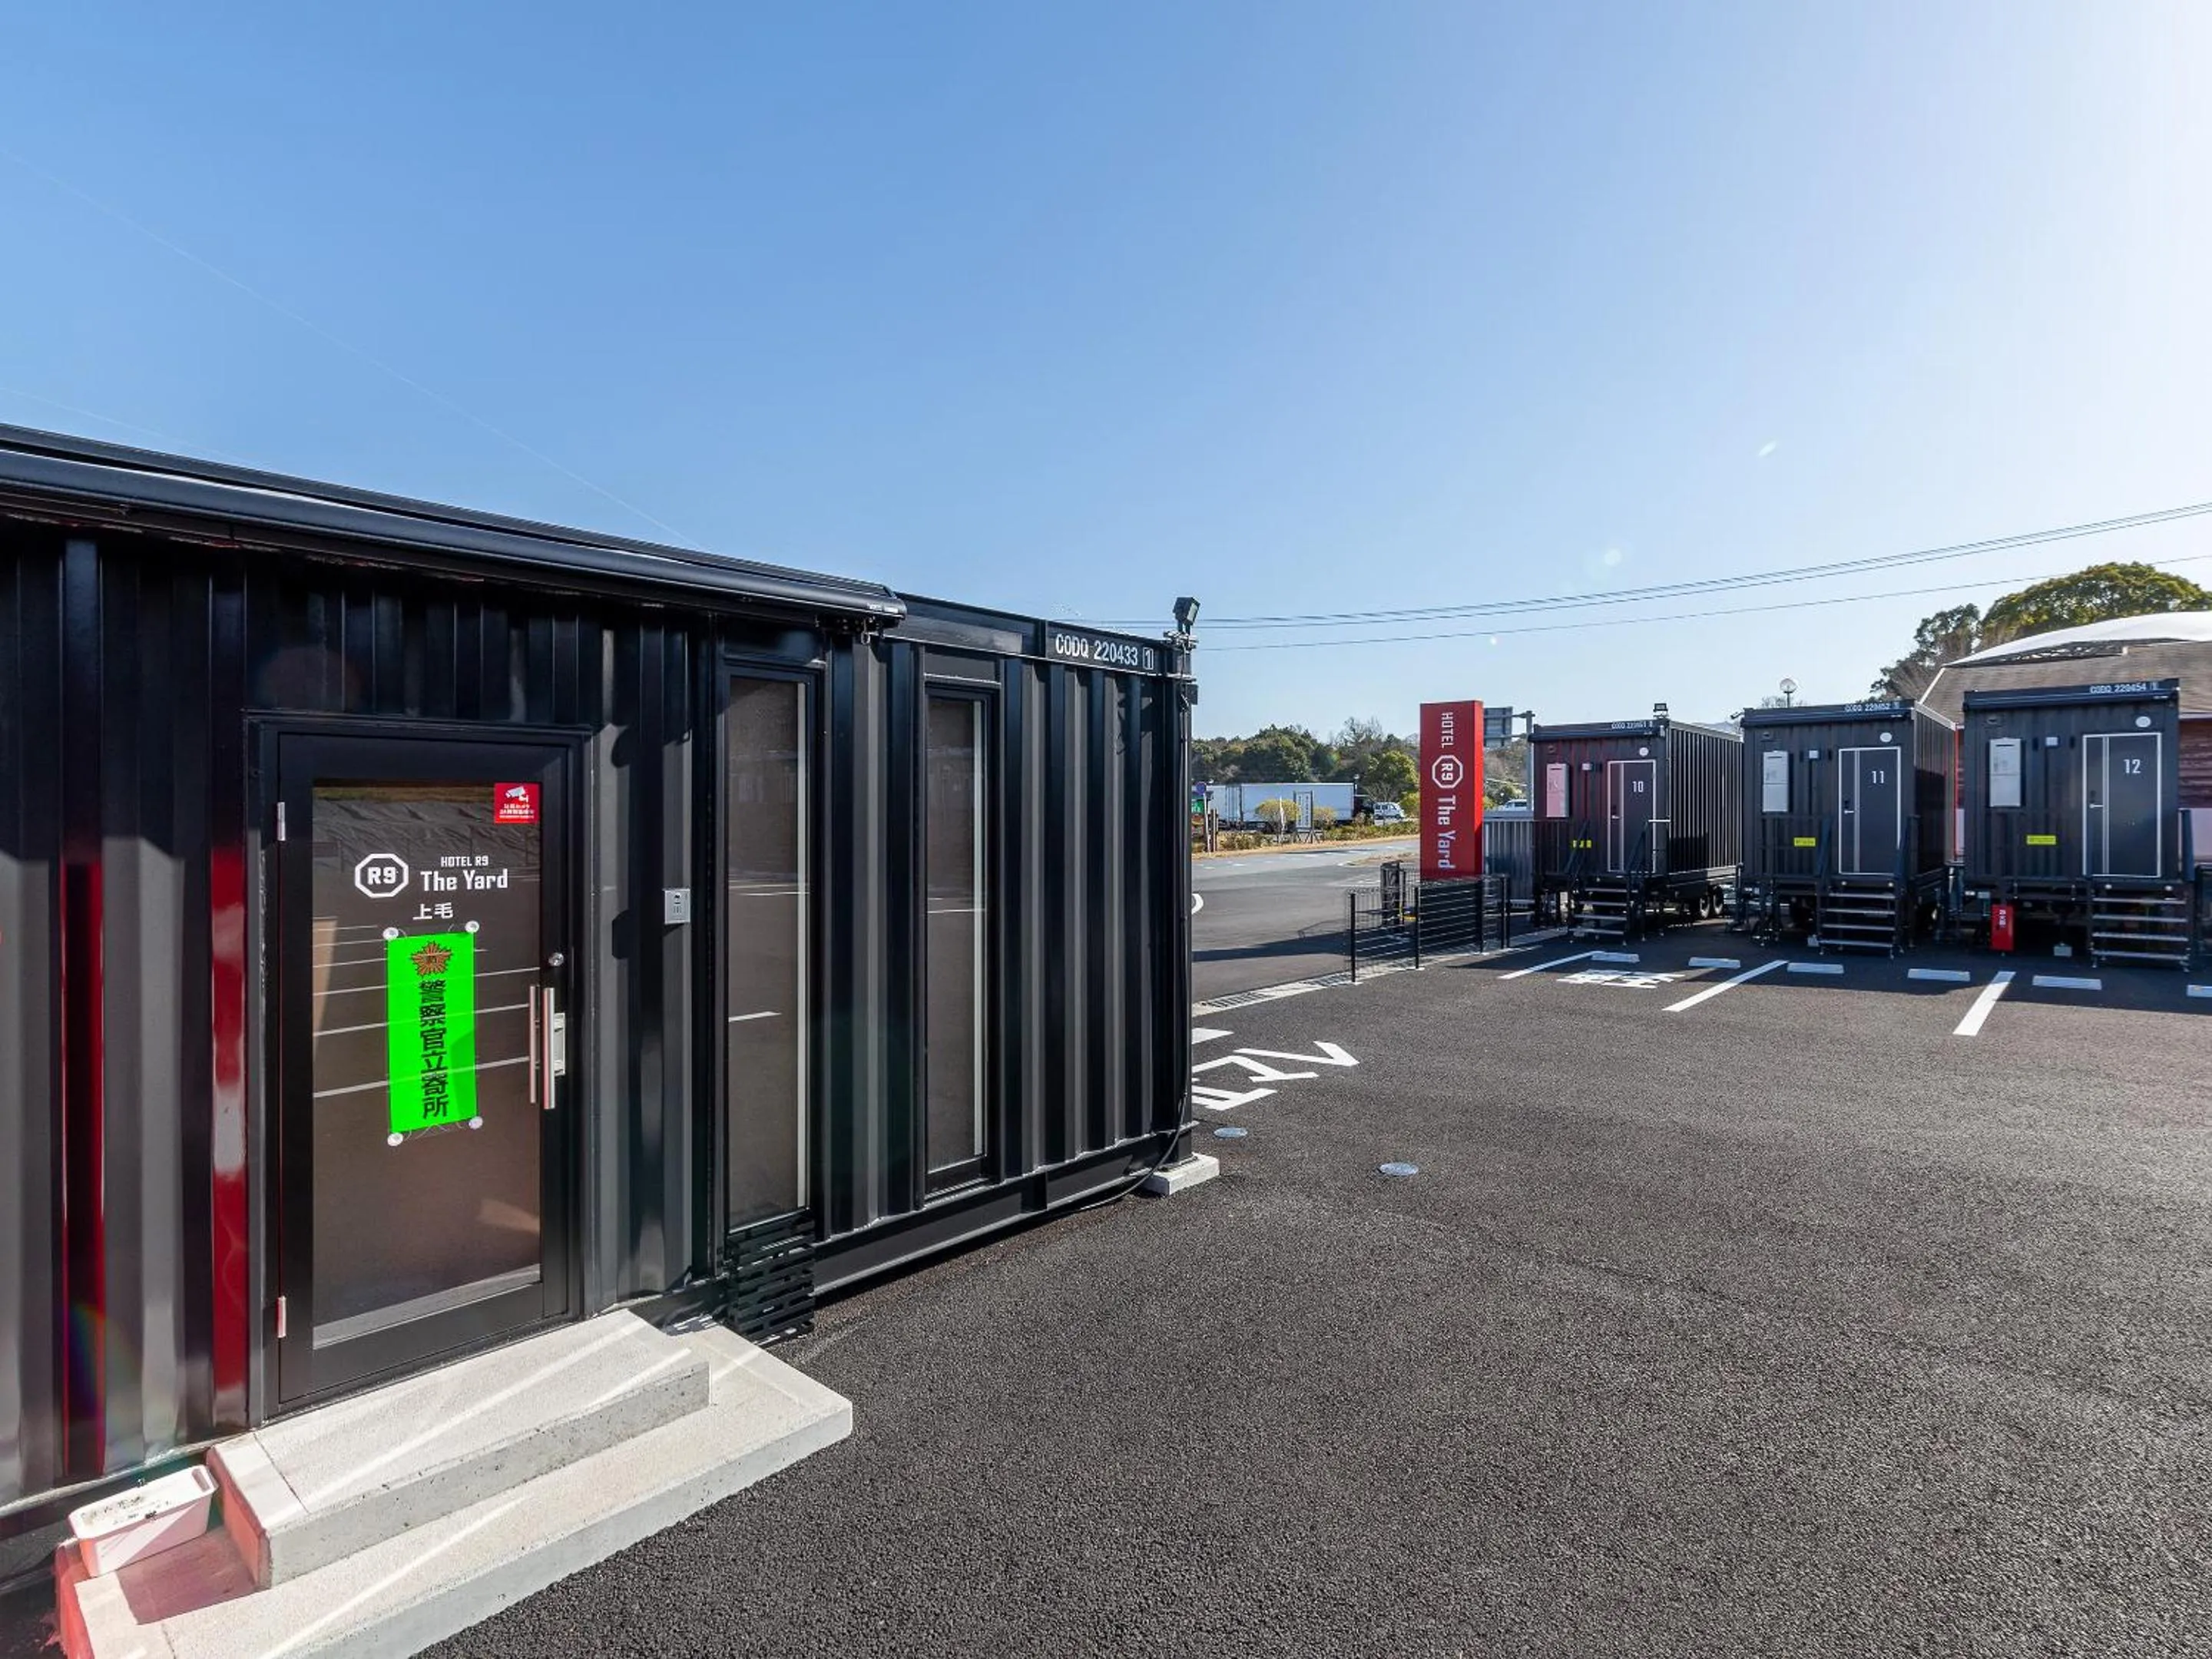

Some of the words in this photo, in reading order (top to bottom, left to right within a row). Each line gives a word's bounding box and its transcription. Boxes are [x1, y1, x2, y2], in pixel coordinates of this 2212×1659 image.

[1094, 641, 1138, 666] 220433
[1440, 711, 1454, 748] HOTEL
[1440, 763, 1454, 781] R9
[2124, 758, 2141, 774] 12
[1871, 770, 1885, 783] 11
[1631, 780, 1644, 793] 10
[1437, 795, 1455, 825] The
[1437, 830, 1456, 869] Yard
[440, 856, 472, 867] HOTEL
[474, 856, 489, 866] R9
[367, 866, 396, 885] R9
[420, 870, 458, 892] The
[462, 868, 508, 889] Yard
[412, 902, 453, 920] 上毛
[419, 979, 449, 1119] 警察官立寄所
